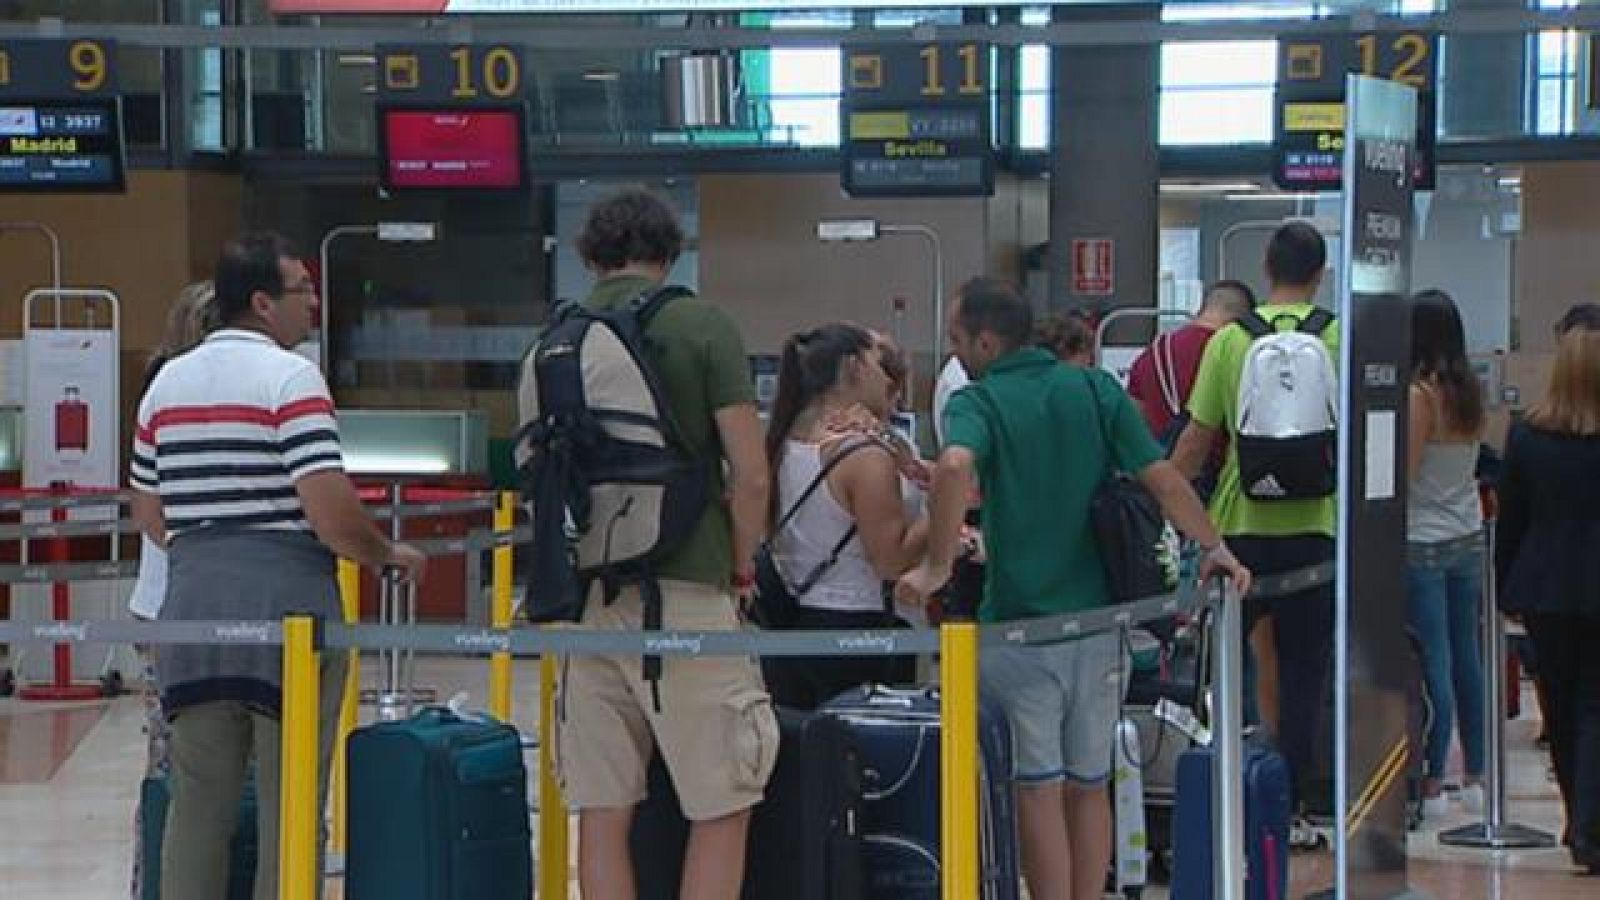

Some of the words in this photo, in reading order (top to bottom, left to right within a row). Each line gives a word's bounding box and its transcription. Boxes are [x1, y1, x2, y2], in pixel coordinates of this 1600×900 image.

[69, 39, 106, 91] 9
[451, 47, 519, 97] 10
[919, 46, 983, 95] 11
[1355, 34, 1428, 85] 12
[10, 137, 77, 153] Madrid
[884, 140, 946, 156] Sevilla
